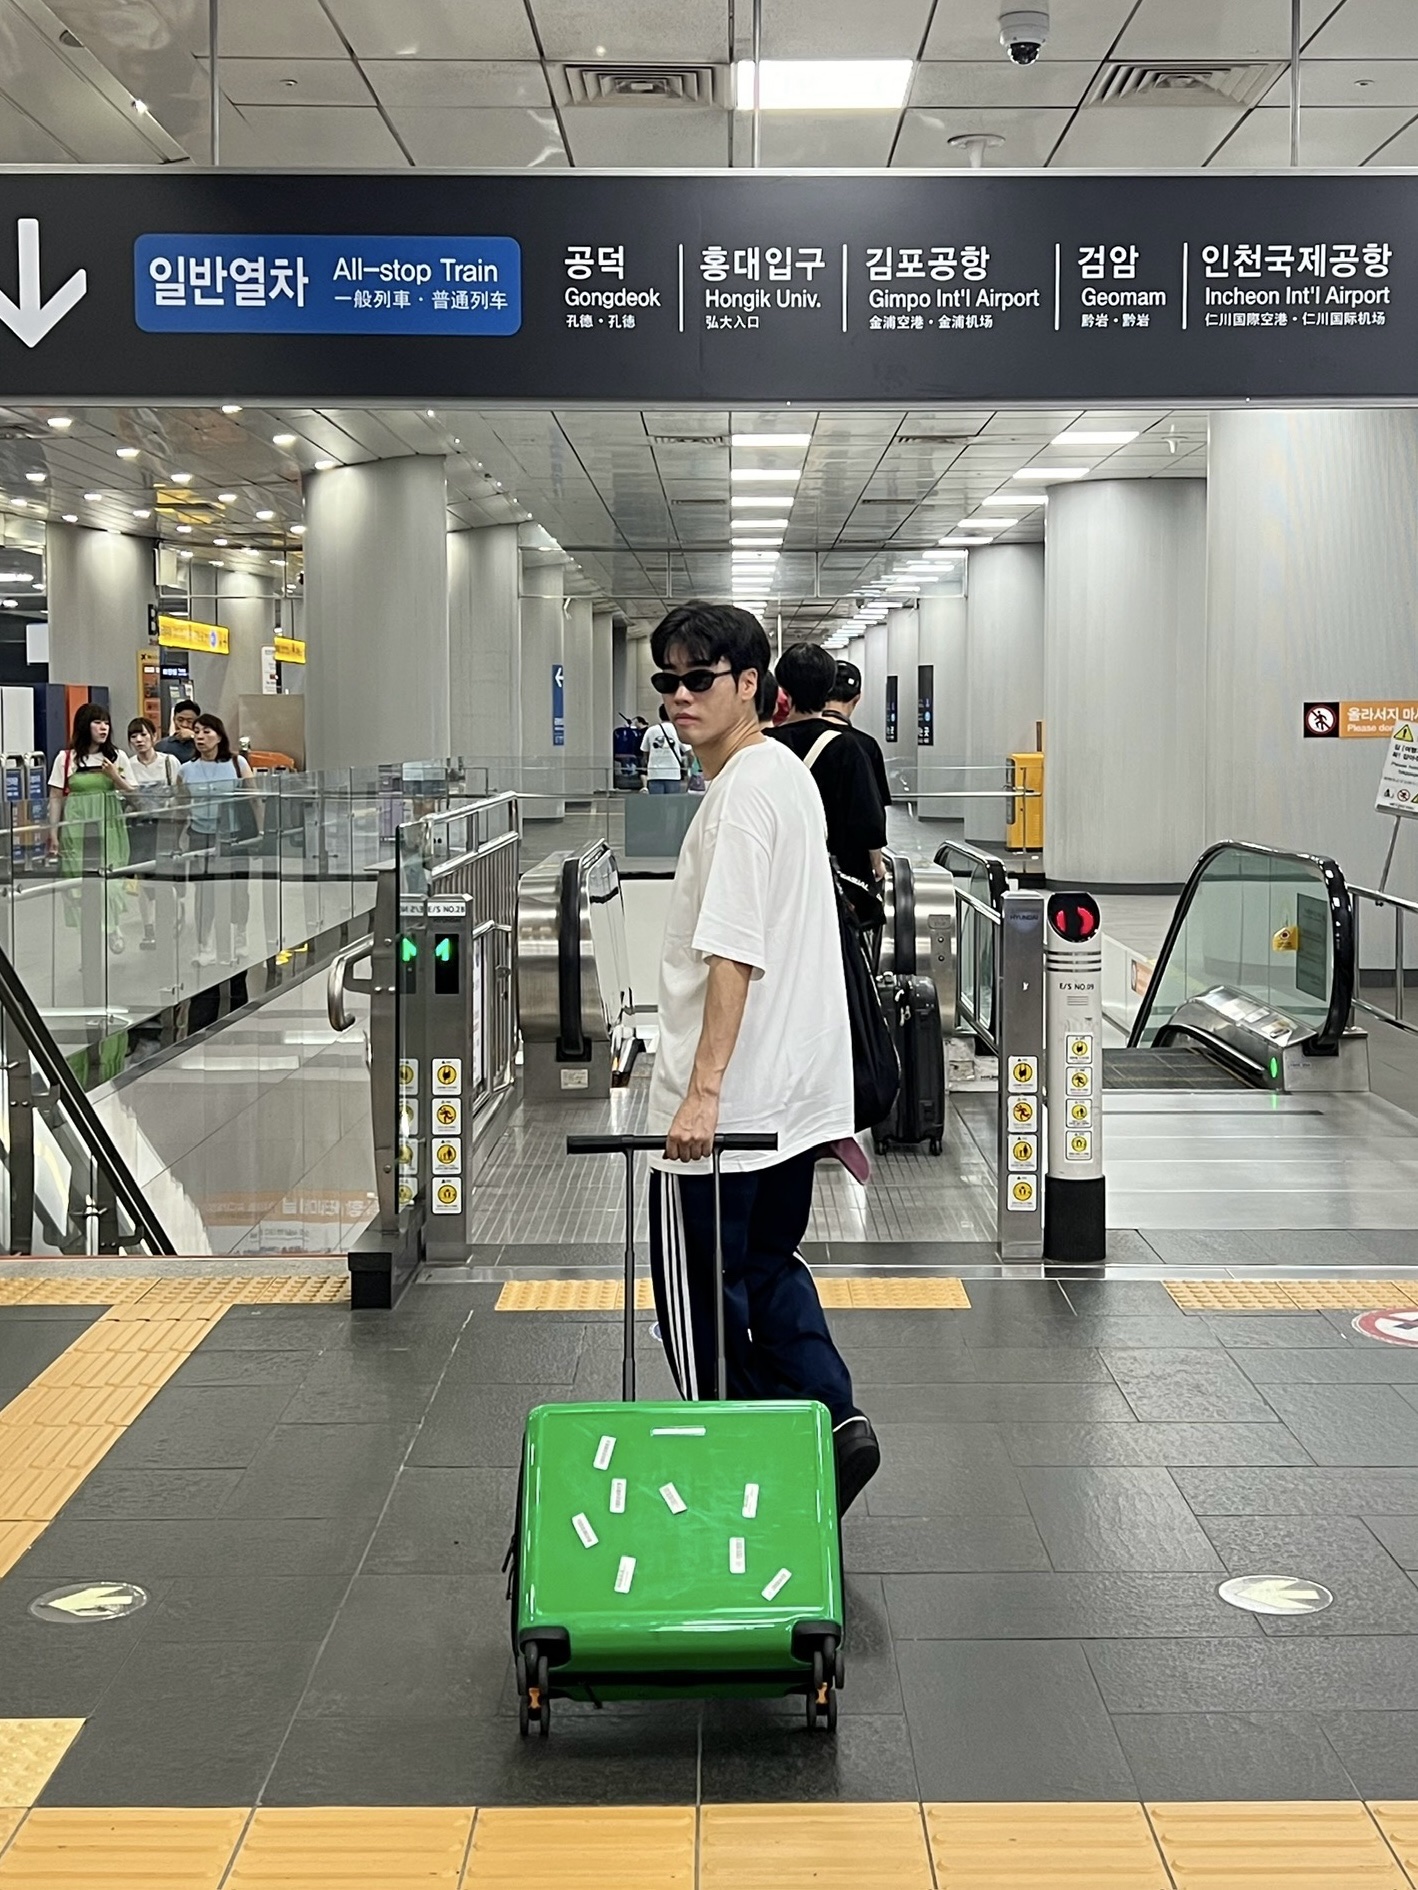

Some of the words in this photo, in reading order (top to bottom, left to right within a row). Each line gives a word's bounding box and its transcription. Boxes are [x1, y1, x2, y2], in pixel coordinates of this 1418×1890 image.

[333, 256, 433, 285] All-stop
[440, 257, 499, 283] Train
[564, 245, 625, 280] 공덕
[699, 245, 826, 281] 홍대입구
[866, 246, 991, 282] 김포공항
[1077, 245, 1140, 280] 검암
[1201, 243, 1393, 279] 인천국제공항
[149, 255, 309, 307] 일반열차
[564, 287, 662, 310] Gongdeok
[705, 288, 771, 312] Hongik
[776, 289, 822, 309] Univ.
[868, 288, 931, 312] Gimpo
[936, 288, 971, 308] Int'l
[975, 288, 1041, 312] Airport
[1081, 287, 1167, 308] Geomam
[1205, 286, 1280, 306] Incheon
[1285, 286, 1321, 305] Int'l
[1325, 286, 1391, 309] Airport
[705, 315, 760, 330] 弘大入口
[1347, 707, 1399, 721] 올라서지
[1347, 724, 1377, 733] Please
